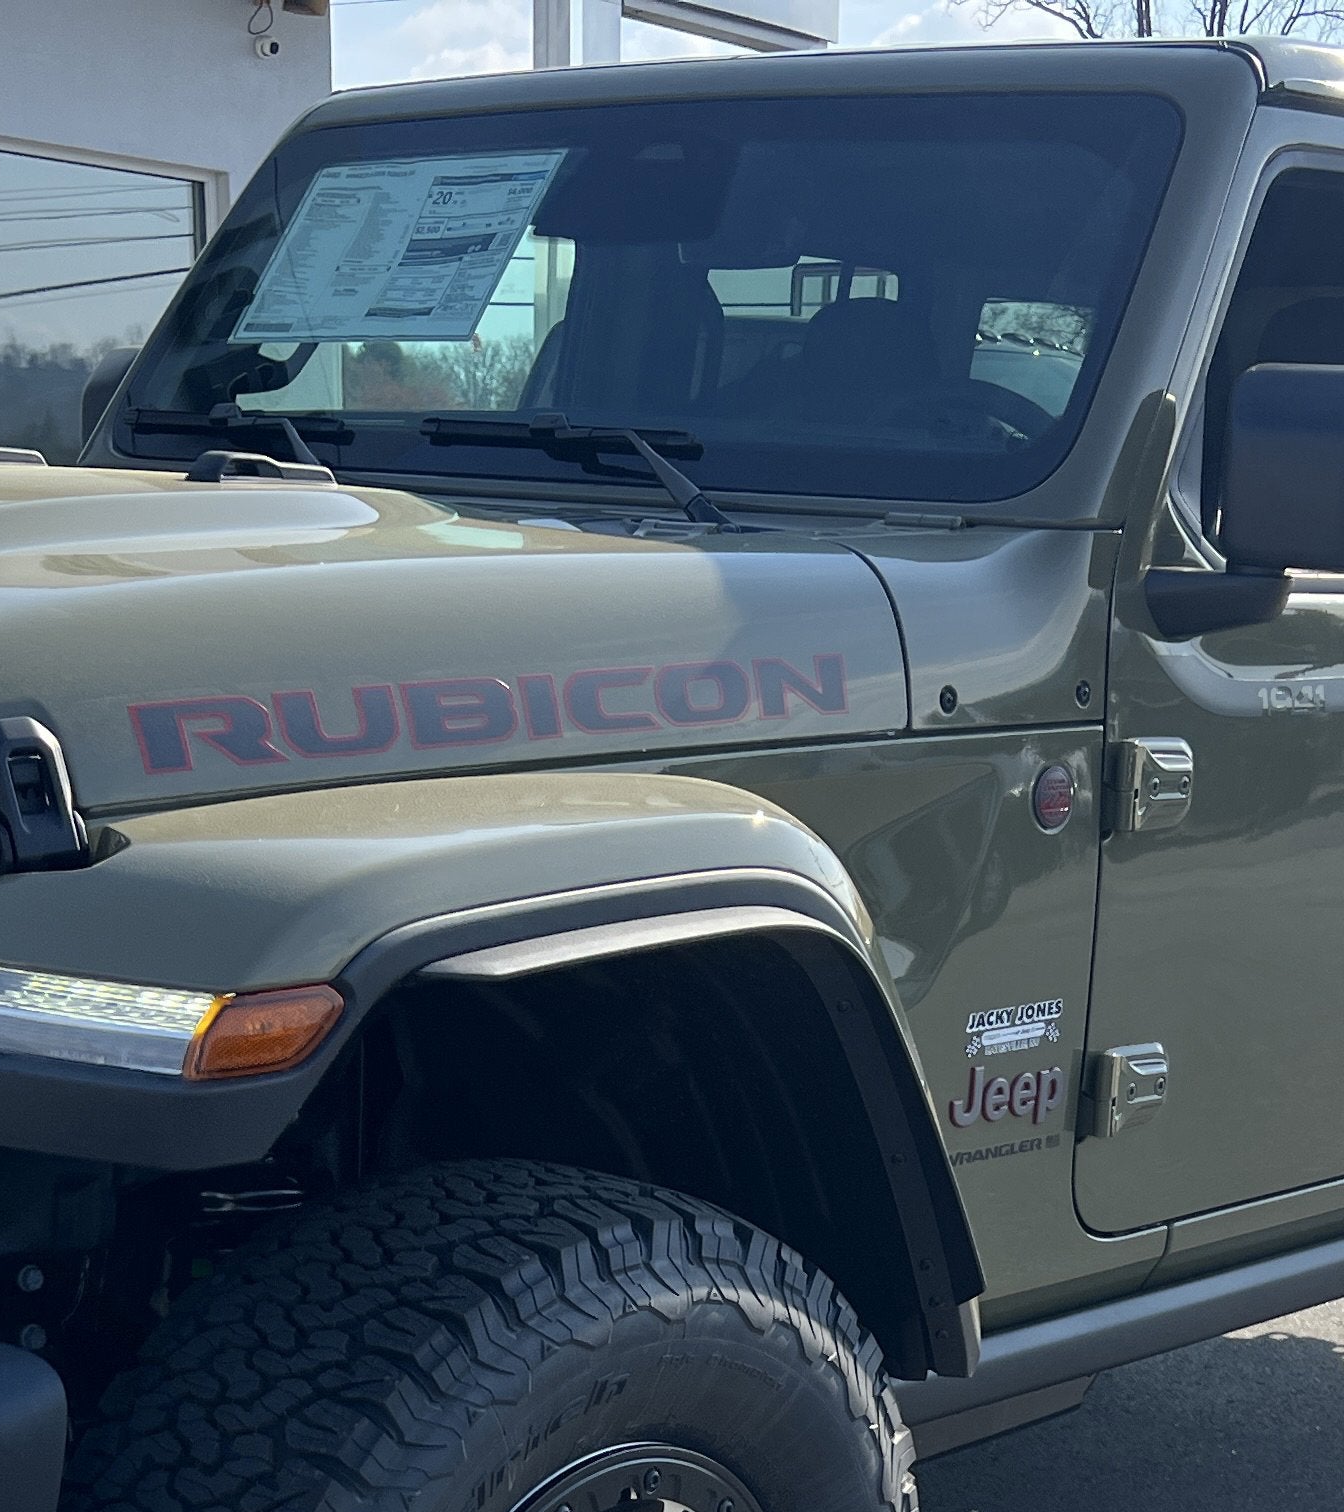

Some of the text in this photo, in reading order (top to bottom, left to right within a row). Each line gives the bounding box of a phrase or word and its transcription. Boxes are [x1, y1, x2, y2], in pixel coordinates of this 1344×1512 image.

[432, 190, 453, 206] 20
[127, 653, 850, 775] RUBICON
[967, 1000, 1062, 1031] JACKY JONES
[950, 1065, 1065, 1128] Jeep
[949, 1136, 1043, 1166] WRANGLER
